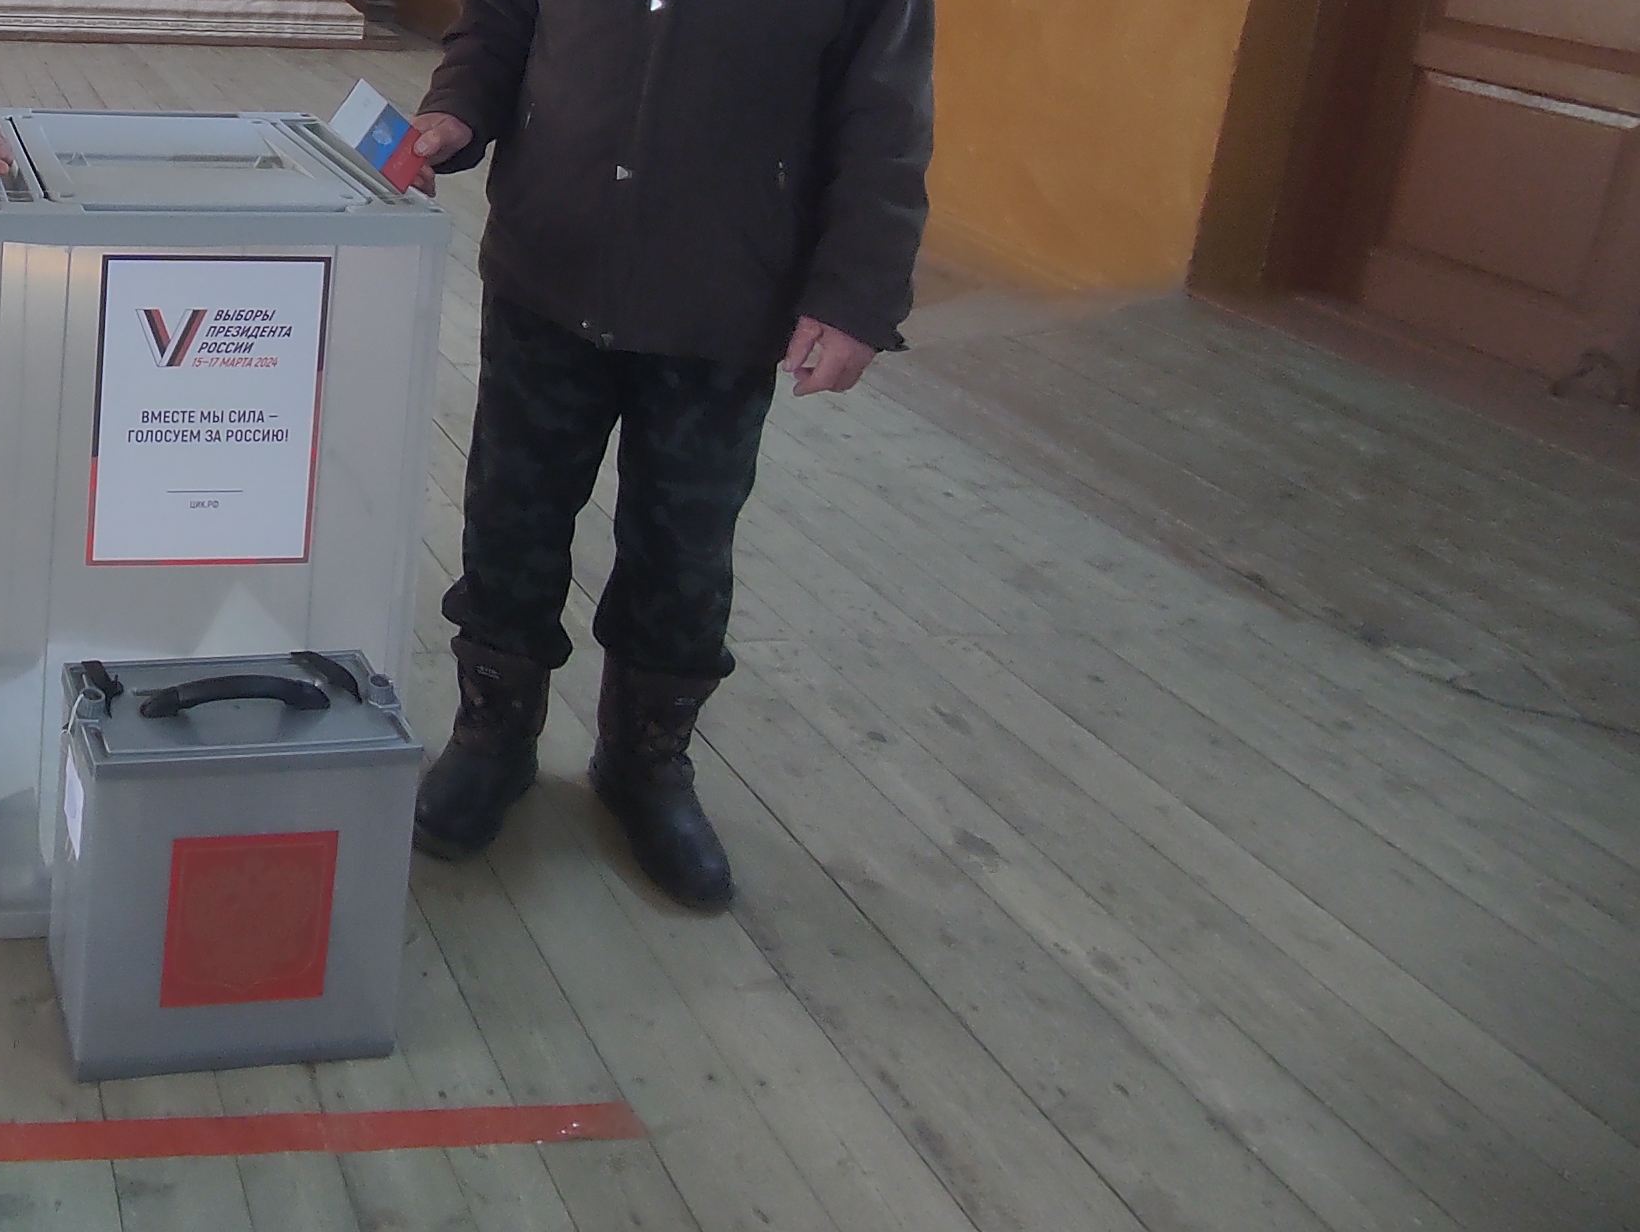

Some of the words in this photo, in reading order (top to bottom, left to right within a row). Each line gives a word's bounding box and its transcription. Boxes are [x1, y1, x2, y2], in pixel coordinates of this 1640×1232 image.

[213, 309, 276, 322] ВЫБОРЫ
[205, 325, 293, 339] ПРЕЗИДЕНТА
[197, 341, 255, 354] РОССИИ
[219, 357, 253, 367] МАРТА
[254, 357, 279, 367] 2024
[141, 410, 195, 423] ВМЕСТЕ
[199, 410, 224, 423] МЫ
[228, 410, 265, 423] СИЛА
[127, 429, 201, 443] ГОЛОСУЕМ
[204, 429, 222, 443] ЗА
[225, 429, 289, 442] РОССИЮ!
[189, 500, 219, 509] ЦИК.РФ
